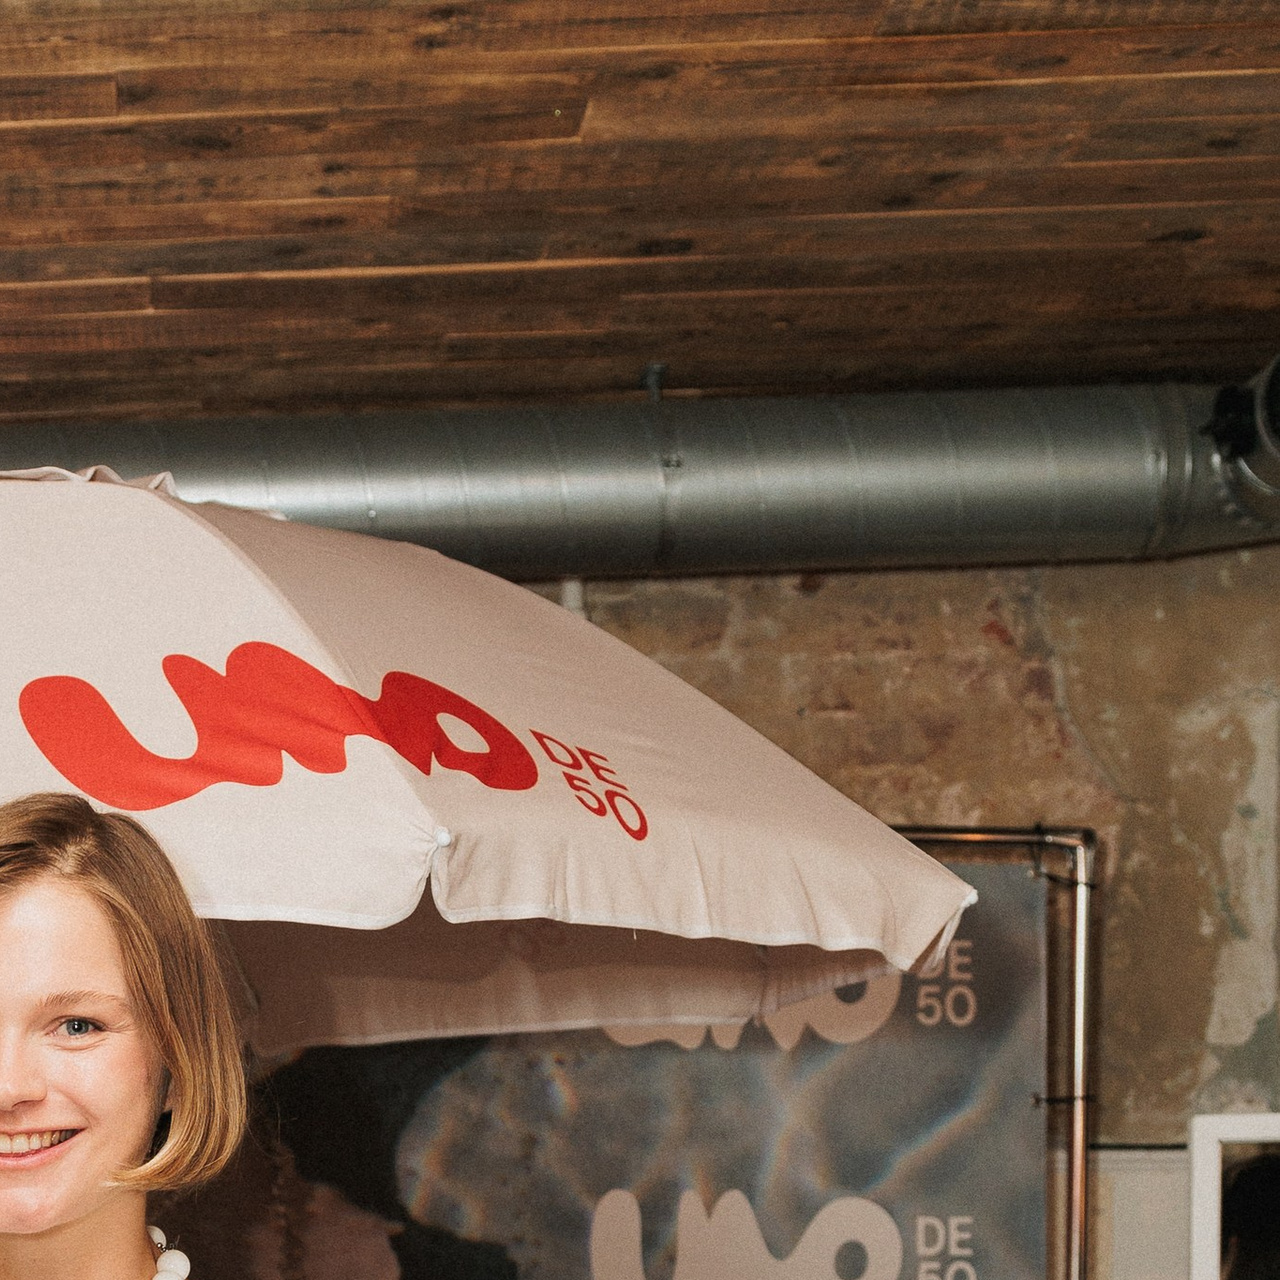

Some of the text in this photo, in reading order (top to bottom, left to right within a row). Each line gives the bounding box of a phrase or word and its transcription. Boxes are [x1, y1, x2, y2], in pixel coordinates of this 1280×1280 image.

[528, 728, 628, 792] DE
[562, 775, 648, 841] 50
[915, 985, 978, 1026] 50
[916, 1216, 974, 1257] DE
